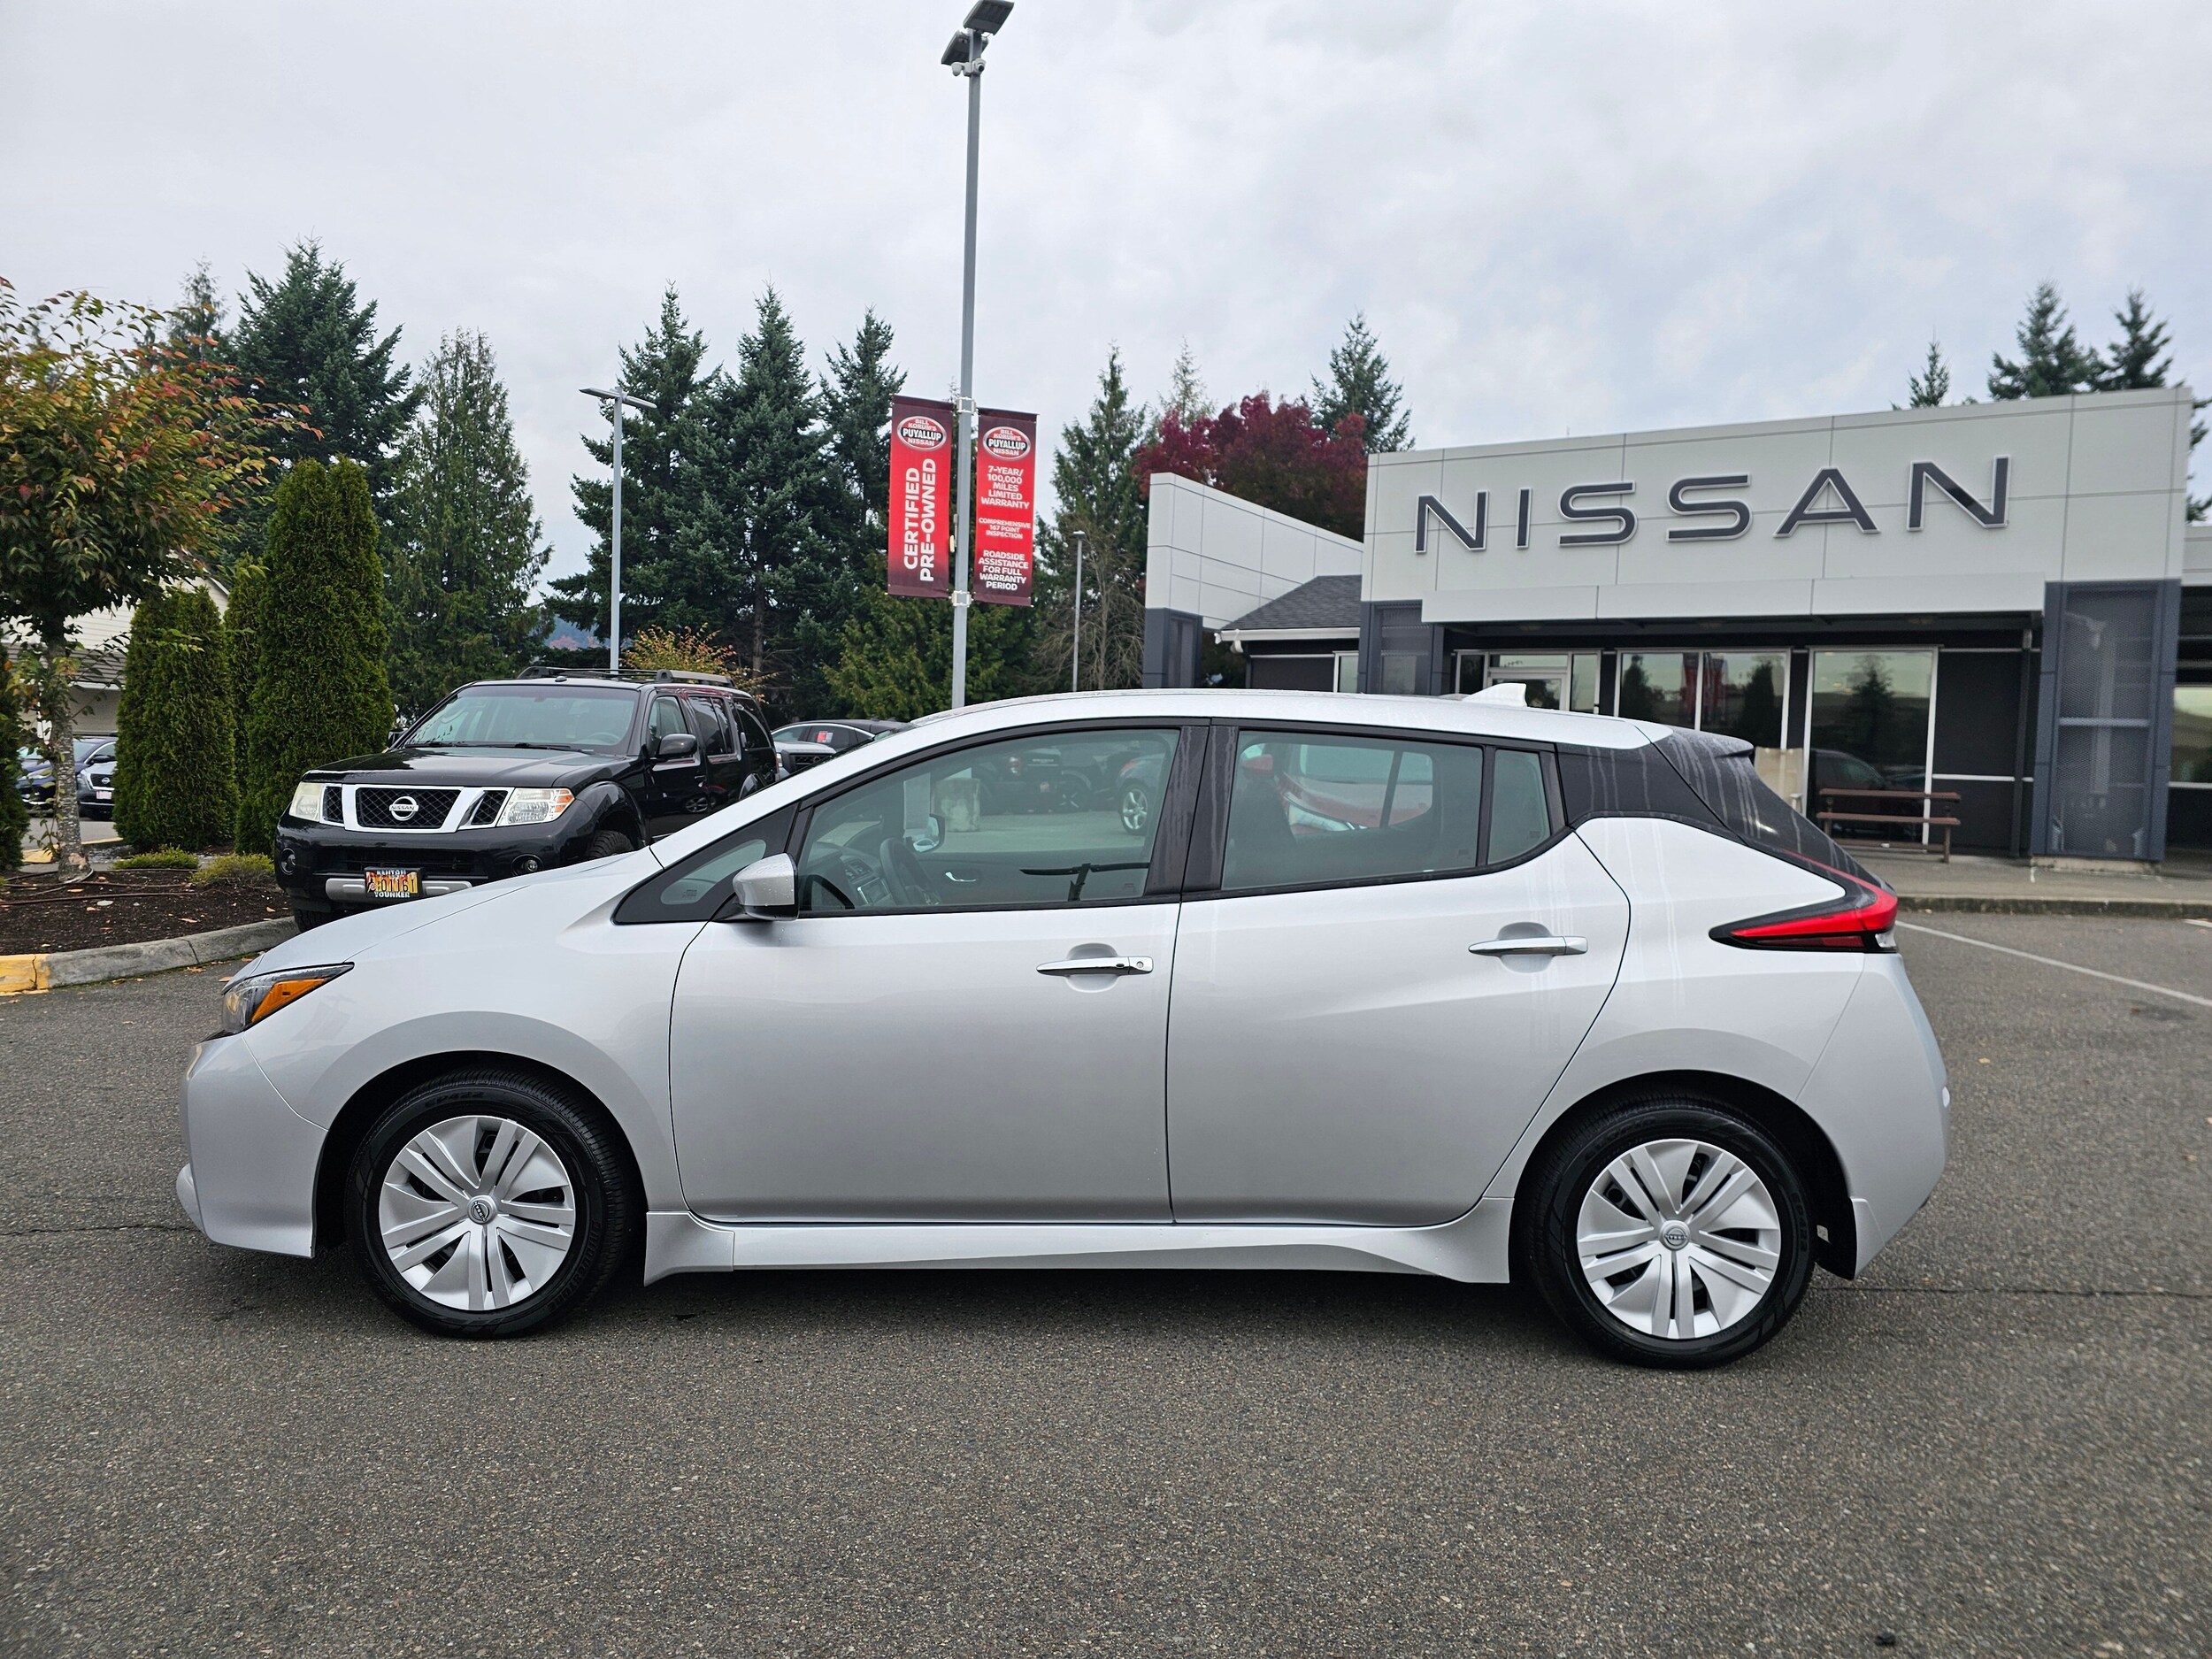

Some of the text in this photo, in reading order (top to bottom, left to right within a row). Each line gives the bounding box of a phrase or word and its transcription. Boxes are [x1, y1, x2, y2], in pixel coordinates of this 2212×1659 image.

[902, 428, 941, 441] PUYALLUP
[988, 439, 1026, 450] PUYALLUP
[988, 465, 1024, 476] 7-YEAR/
[987, 473, 1023, 484] 100,000
[993, 482, 1018, 492] MILES
[988, 489, 1023, 500] LIMITED
[981, 496, 1030, 509] WARRANTY
[1414, 454, 2010, 554] NISSAN
[903, 467, 920, 570] CERTIFIED
[920, 458, 936, 582] PRE-OWNED
[979, 518, 1031, 528] COMPREHENSIVE
[986, 530, 1023, 539] INSPECTION
[983, 549, 1025, 561] ROADSIDE
[979, 557, 1029, 569] ASSISTANCE
[1002, 567, 1022, 576] FULL
[979, 572, 1026, 584] WARRANTY
[986, 580, 1018, 591] PERIOD
